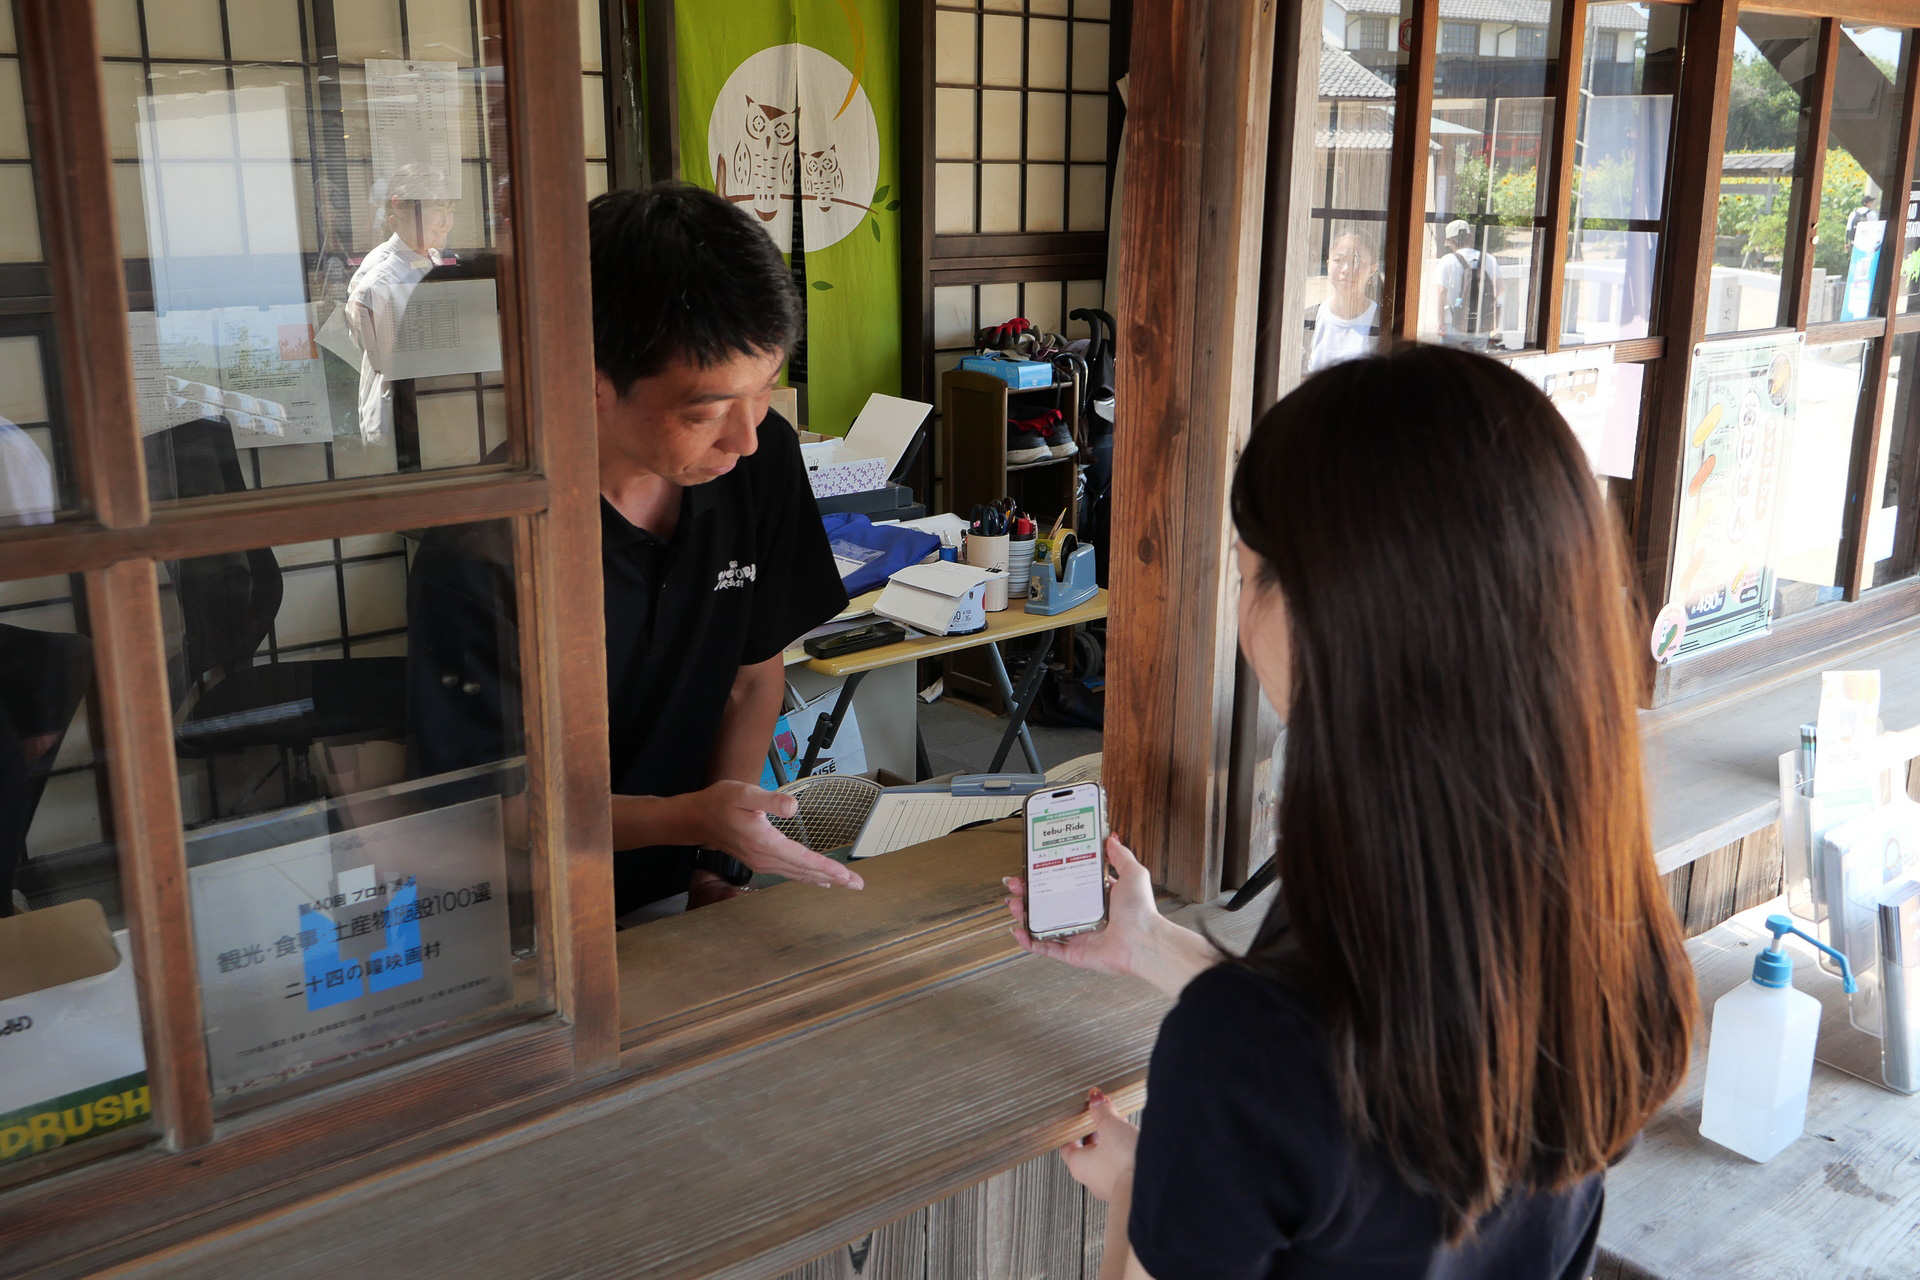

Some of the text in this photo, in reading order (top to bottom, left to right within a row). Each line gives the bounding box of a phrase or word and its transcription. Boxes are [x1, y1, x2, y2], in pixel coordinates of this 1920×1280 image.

[1043, 822, 1085, 837] tebu-Ride
[284, 940, 441, 999] 二十四の瞳映画村
